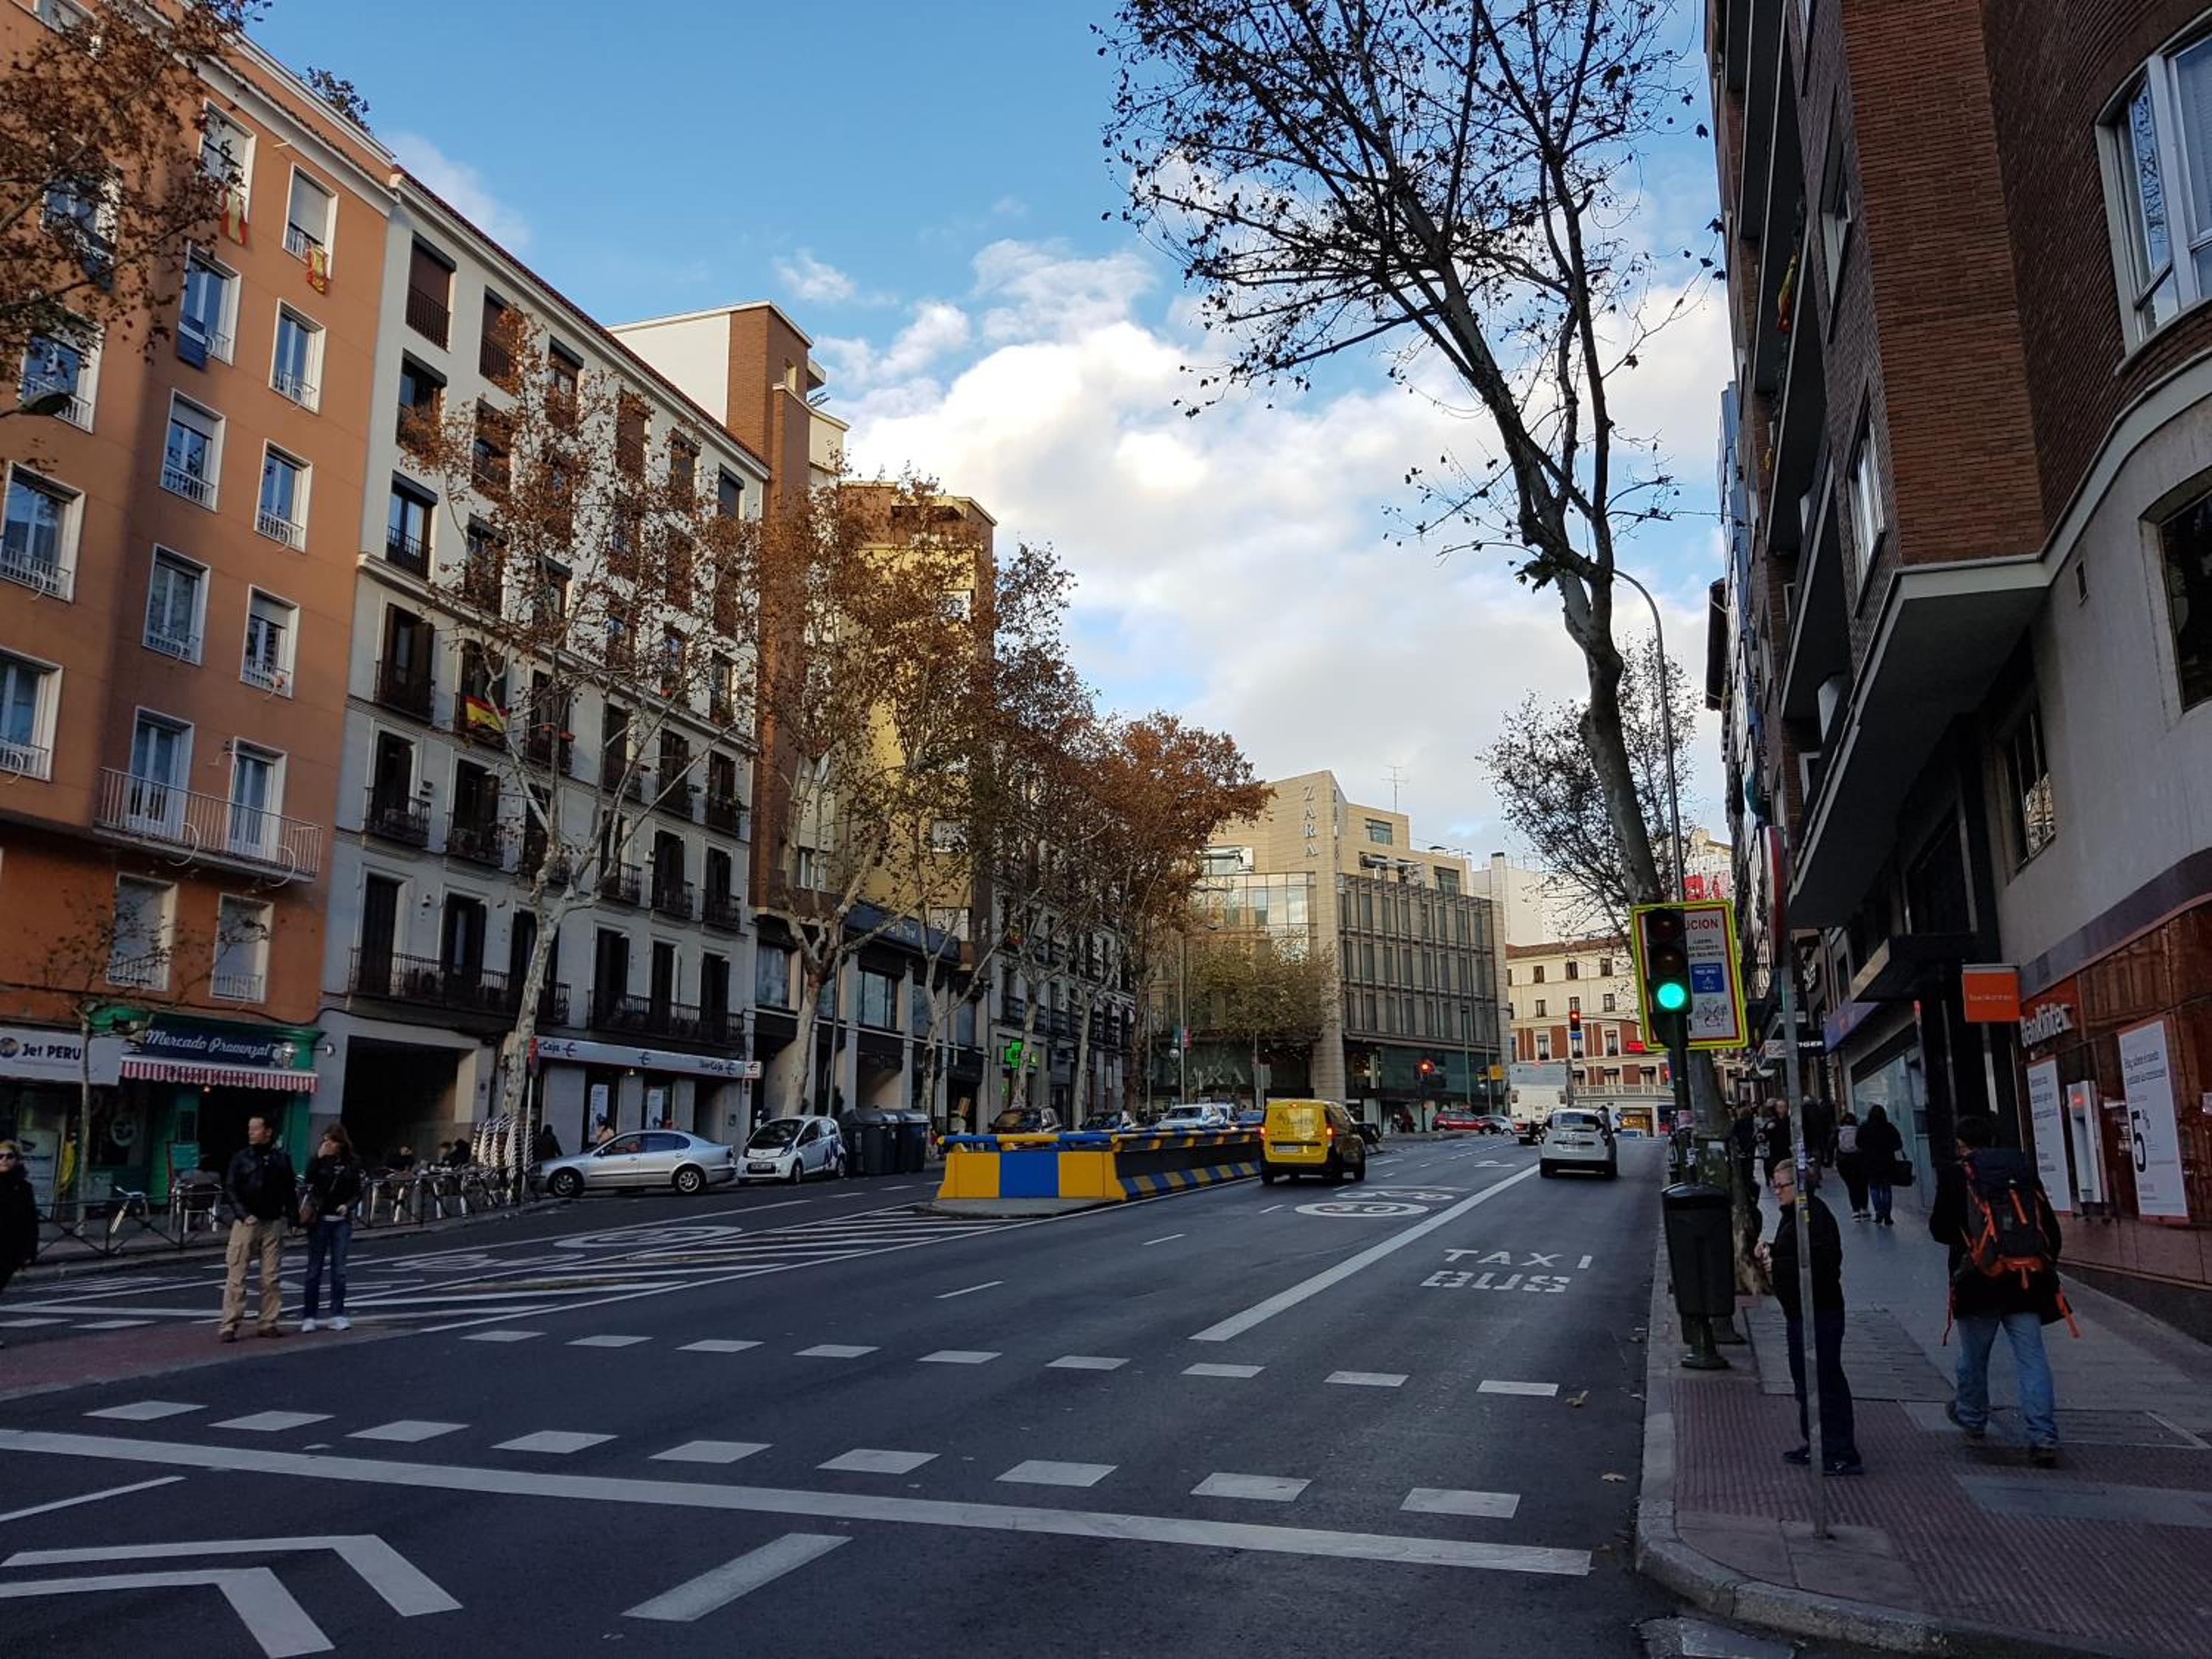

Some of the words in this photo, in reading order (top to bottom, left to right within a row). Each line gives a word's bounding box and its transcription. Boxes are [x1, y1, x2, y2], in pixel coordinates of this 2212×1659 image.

[1303, 784, 1319, 858] ZARA
[21, 1043, 43, 1057] Jet
[46, 1045, 81, 1060] PERU
[144, 1029, 207, 1051] Mercado
[207, 1037, 270, 1060] Provenzal
[1170, 1065, 1247, 1085] ARA
[1443, 1248, 1593, 1269] TAXI
[1419, 1270, 1572, 1293] BUS
